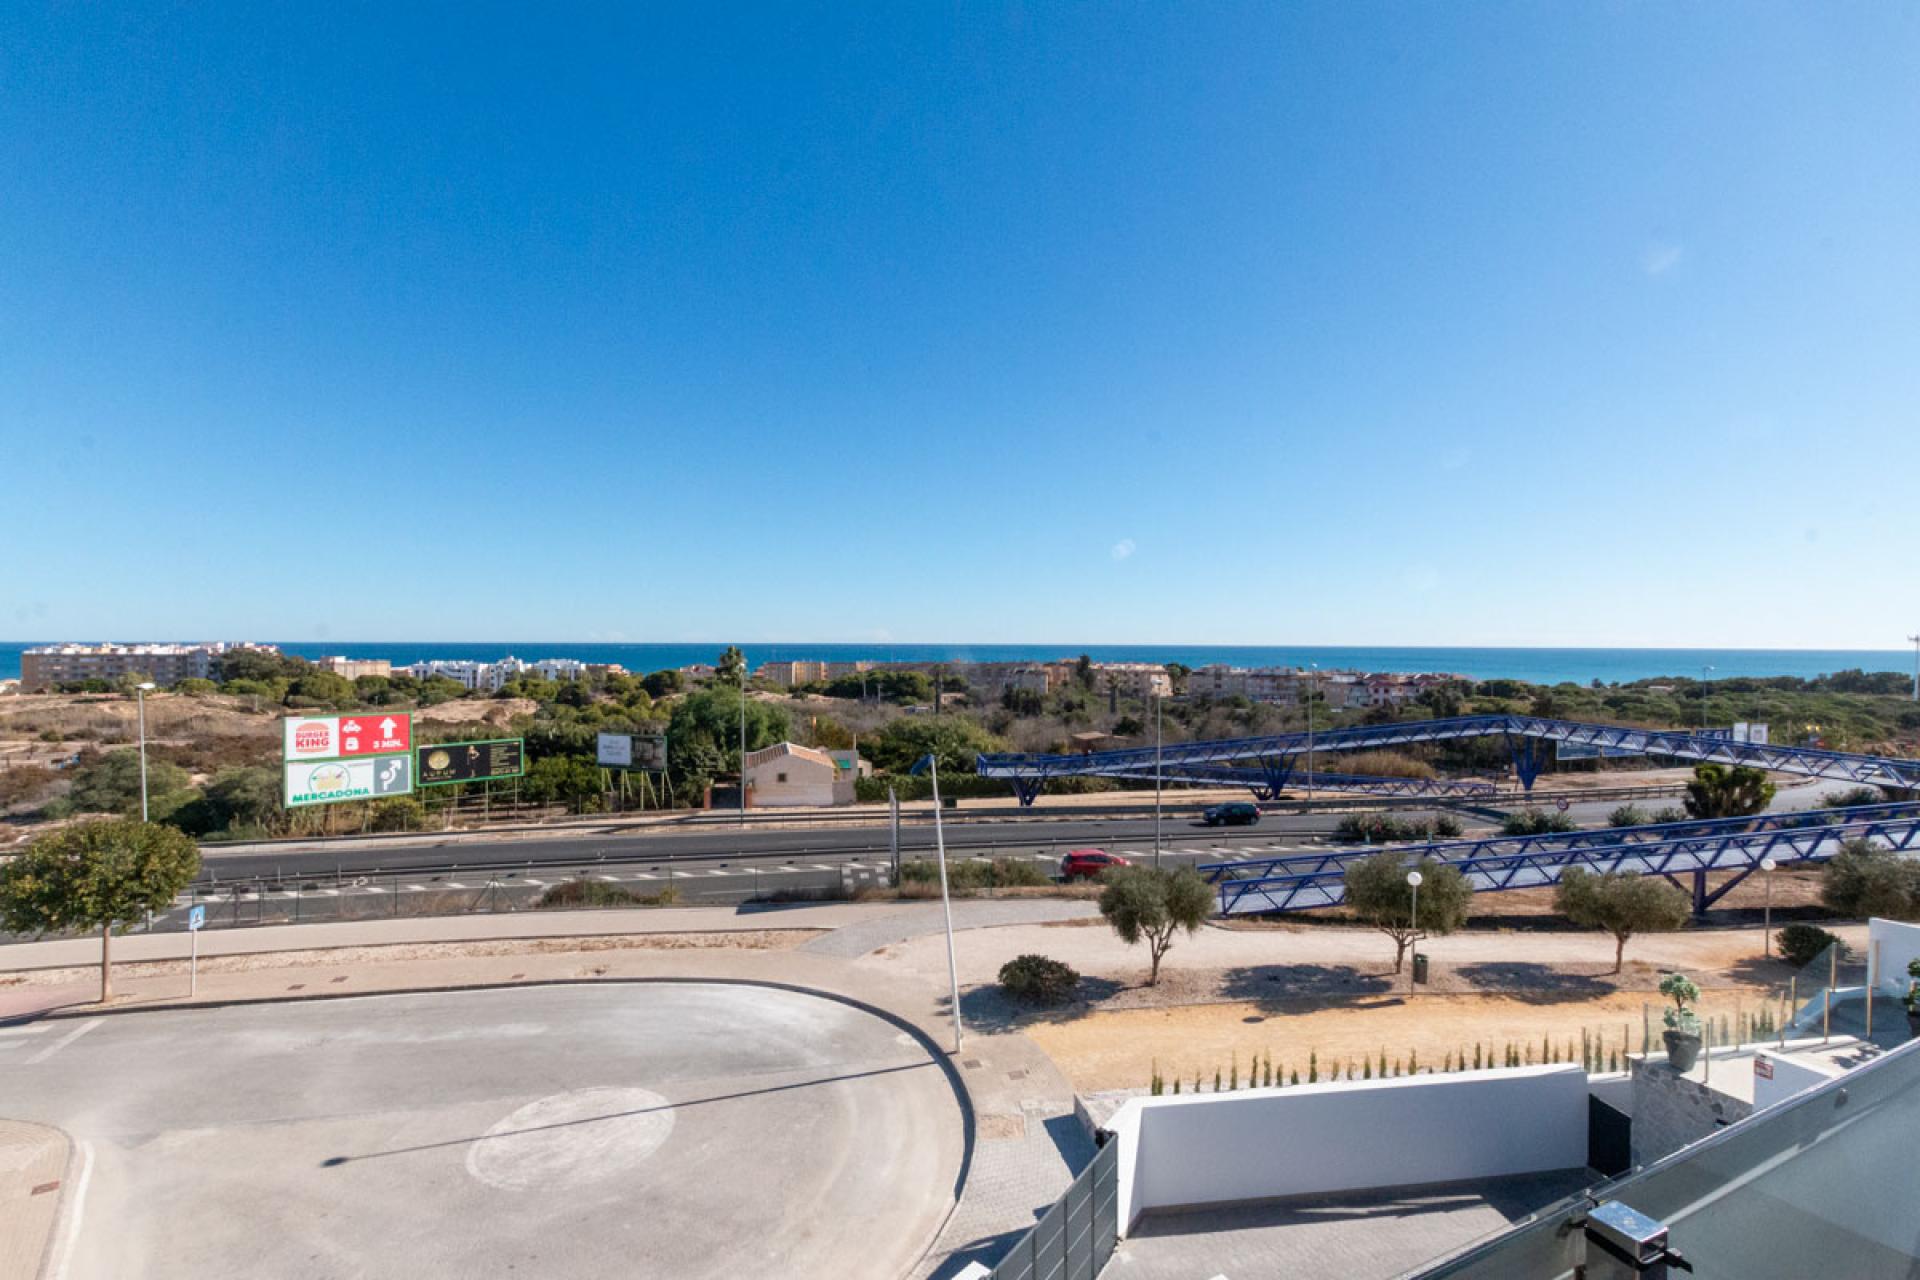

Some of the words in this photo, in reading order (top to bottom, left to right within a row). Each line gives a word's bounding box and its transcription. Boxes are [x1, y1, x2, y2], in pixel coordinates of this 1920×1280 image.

[296, 731, 329, 739] BURGER
[296, 738, 329, 748] KING
[292, 787, 370, 802] MERCADONA
